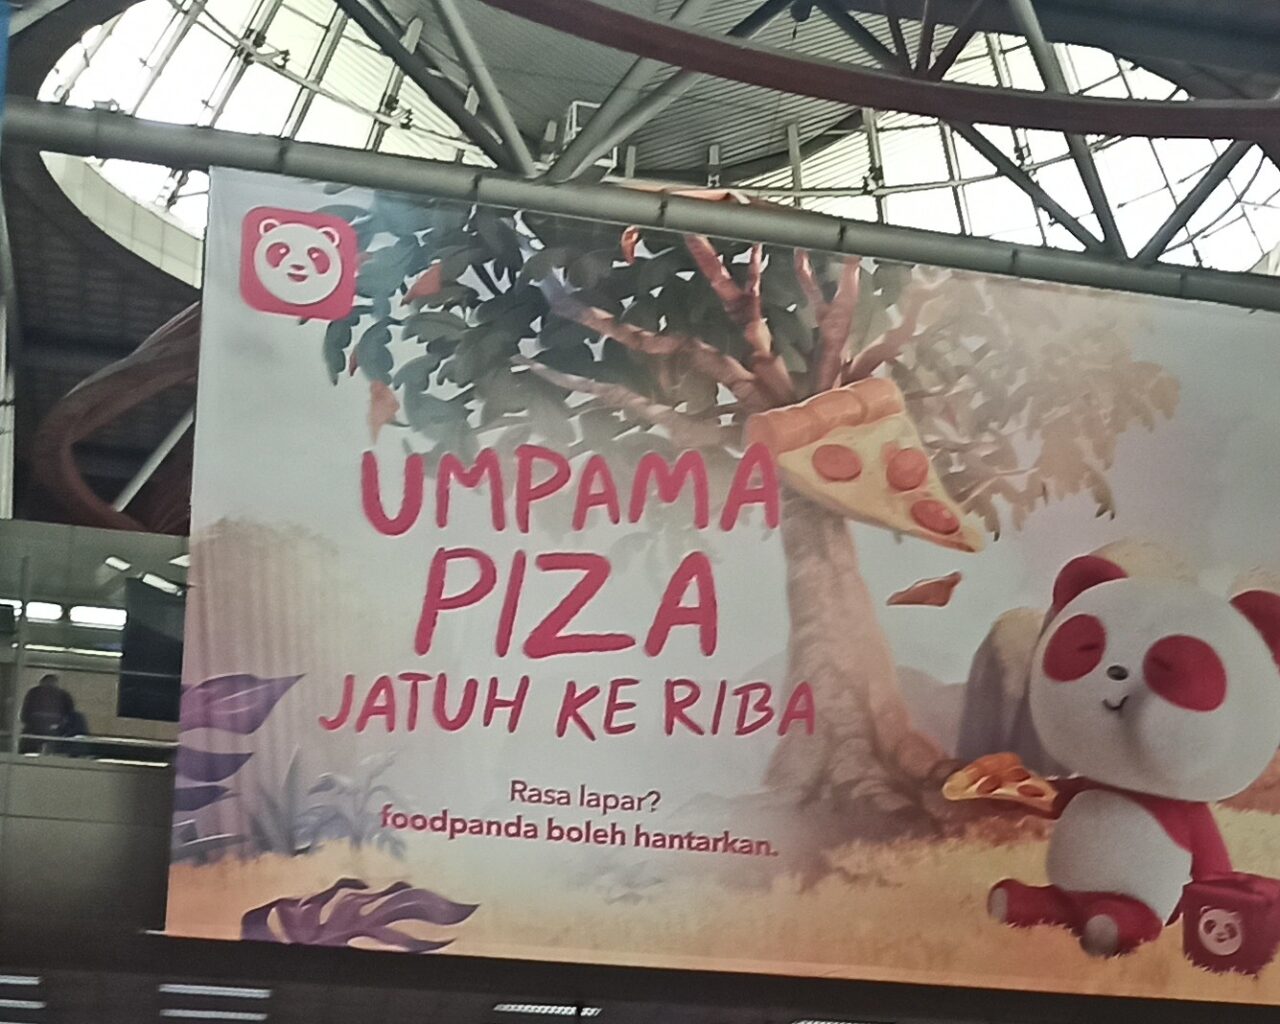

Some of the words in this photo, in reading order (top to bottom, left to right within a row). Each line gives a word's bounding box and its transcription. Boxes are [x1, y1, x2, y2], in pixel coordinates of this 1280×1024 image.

[361, 442, 780, 536] UMPAMA
[414, 547, 718, 659] PIZA
[318, 672, 530, 734] JATUH
[556, 678, 640, 742] KE
[663, 678, 816, 738] RIBA
[379, 803, 539, 840] foodpanda
[546, 817, 627, 847] boleh
[634, 824, 779, 858] hantarkan.
[510, 779, 571, 806] Rasa
[579, 784, 662, 815] lapar?
